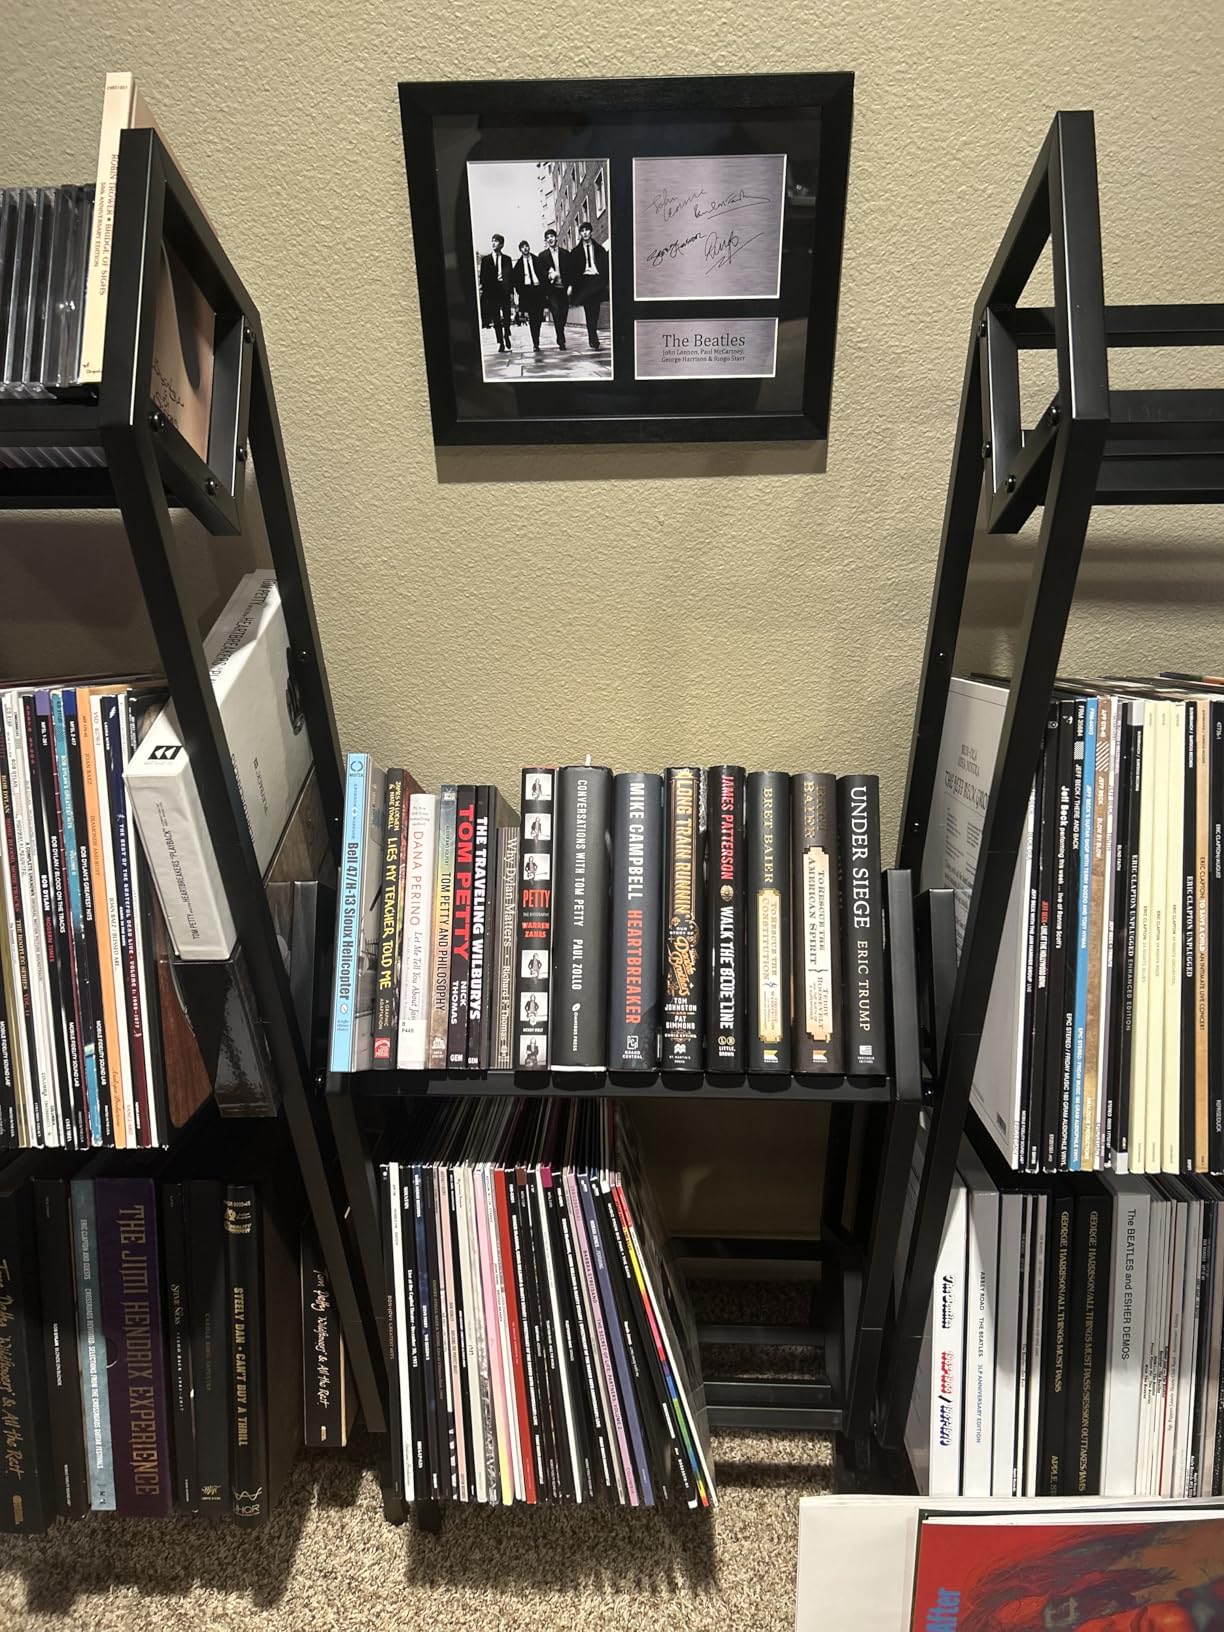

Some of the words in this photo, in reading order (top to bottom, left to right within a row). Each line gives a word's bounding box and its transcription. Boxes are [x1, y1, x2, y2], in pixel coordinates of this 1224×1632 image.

[108, 154, 119, 180] ROBIN
[106, 182, 117, 216] TROWER
[94, 196, 104, 238] ANNIVERSARY
[93, 240, 102, 267] EDITION
[102, 224, 112, 254] BRIDGE
[102, 257, 110, 267] OF
[99, 270, 109, 296] SIGHS
[662, 334, 689, 348] The
[694, 332, 746, 347] Beatles
[249, 590, 271, 606] PETTY
[261, 578, 276, 590] TOM
[212, 618, 255, 666] HEARTBREAKERS
[629, 783, 645, 819] MIKE
[676, 780, 692, 814] LONG
[721, 774, 734, 810] JAMES
[762, 787, 773, 828] BRET
[1060, 786, 1070, 802] Jeff
[576, 780, 588, 849] CONVERSATIONS
[804, 780, 815, 839] BAIER
[850, 786, 868, 861] UNDER
[1060, 804, 1070, 826] Beck
[458, 804, 474, 862] TOM
[476, 817, 488, 845] THE
[674, 818, 692, 859] TRAIN
[1058, 827, 1066, 858] performing
[348, 842, 359, 864] Bell
[386, 838, 398, 862] LIES
[412, 831, 424, 870] DANA
[504, 838, 518, 864] Why
[628, 824, 645, 900] CAMPBELL
[720, 814, 734, 880] PATTERSON
[764, 833, 774, 883] BAIER
[81, 858, 89, 881] DYLAN'S
[386, 865, 397, 882] MY
[575, 852, 586, 874] WITH
[56, 892, 62, 900] ON
[171, 860, 190, 903] HEARTBREAKERS
[345, 866, 358, 907] 47/H-13
[440, 872, 452, 892] TOM
[472, 848, 487, 935] TRAVELING
[503, 867, 517, 900] Dylan
[574, 878, 585, 894] TOM
[808, 857, 817, 919] AMERICAN
[1130, 874, 1138, 910] CLAPTON
[382, 885, 396, 939] TEACHER
[410, 876, 422, 926] PERINO
[439, 895, 450, 924] PETTY
[522, 890, 552, 908] PETTY
[574, 900, 585, 927] PETTY
[853, 867, 871, 929] SIEGE
[46, 916, 54, 938] MODERN
[186, 914, 198, 928] PETTY
[343, 908, 356, 939] Sioux
[454, 872, 472, 961] PETTY
[503, 903, 516, 948] Matters
[720, 906, 735, 939] WALK
[191, 929, 201, 940] TOM
[438, 928, 450, 948] AND
[572, 939, 584, 960] PAUL
[762, 898, 770, 980] CONSTITUTION
[809, 922, 818, 965] SPIRIT
[1128, 911, 1136, 957] UNPLUGGED
[380, 940, 393, 968] TOLD
[626, 910, 643, 1024] HEARTBREAKER
[720, 942, 735, 965] THE
[857, 940, 869, 975] ERIC
[338, 940, 354, 1001] Helicopter
[379, 970, 392, 991] ME
[436, 950, 448, 1012] PHILOSOPHY
[470, 939, 485, 1021] WILBURYS
[502, 966, 511, 997] Richard
[572, 964, 583, 990] ZOLLO
[720, 968, 736, 999] BLUE
[1126, 959, 1134, 998] ENHANCED
[450, 980, 459, 1025] THOMAS
[460, 981, 468, 1006] NICK
[859, 980, 871, 1032] TRUMP
[500, 1009, 510, 1041] Thomas
[720, 1002, 735, 1030] LINE
[80, 1219, 88, 1230] ERIC
[116, 1204, 146, 1244] THE
[1127, 1209, 1136, 1226] The
[81, 1231, 90, 1252] CLAPTON
[82, 1252, 90, 1262] AND
[1125, 1228, 1136, 1271] BEATLES
[83, 1262, 91, 1281] GUESTS
[117, 1250, 148, 1294] JIMI
[583, 1250, 591, 1272] BARBRA
[587, 1272, 598, 1304] STREISAND
[1124, 1273, 1133, 1290] and
[234, 1287, 245, 1321] STEELY
[311, 1290, 330, 1312] Petty
[1122, 1292, 1133, 1324] ESHER
[120, 1301, 153, 1380] HENDRIX
[235, 1324, 246, 1344] DAN
[598, 1330, 606, 1350] SECRET
[1122, 1326, 1132, 1360] DEMOS
[88, 1346, 98, 1374] SELECTIONS
[236, 1354, 247, 1382] CAN'T
[90, 1374, 99, 1388] FROM
[91, 1389, 100, 1398] THE
[236, 1384, 248, 1404] BUY
[92, 1398, 102, 1428] CROSSROADS
[237, 1406, 248, 1414] A
[93, 1429, 102, 1445] GUITAR
[128, 1386, 160, 1496] EXPERIENCE
[238, 1416, 248, 1447] THRILL
[94, 1446, 104, 1469] FESTIVALS
